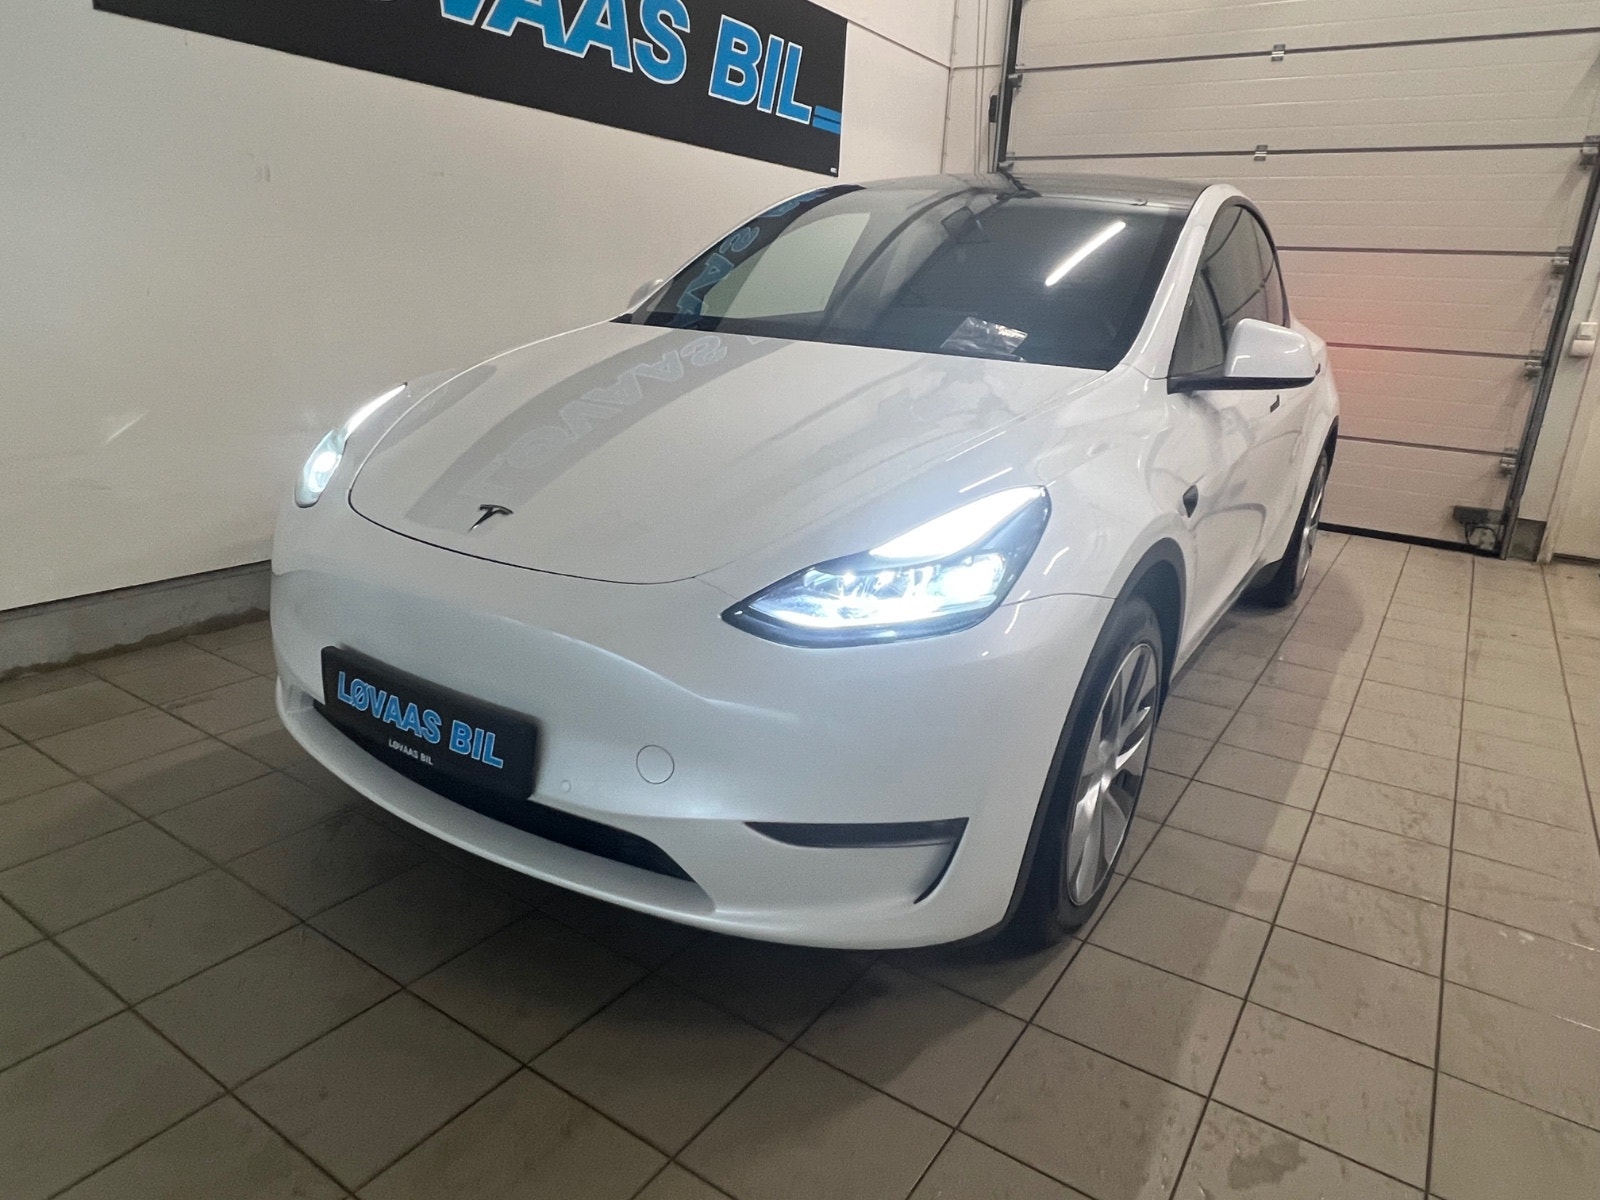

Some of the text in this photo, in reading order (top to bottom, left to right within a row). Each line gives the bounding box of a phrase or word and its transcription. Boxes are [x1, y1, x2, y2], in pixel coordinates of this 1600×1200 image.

[708, 14, 812, 125] BIL
[337, 671, 504, 769] LØVAAS BIL
[388, 738, 434, 766] LØVAAS BIL
